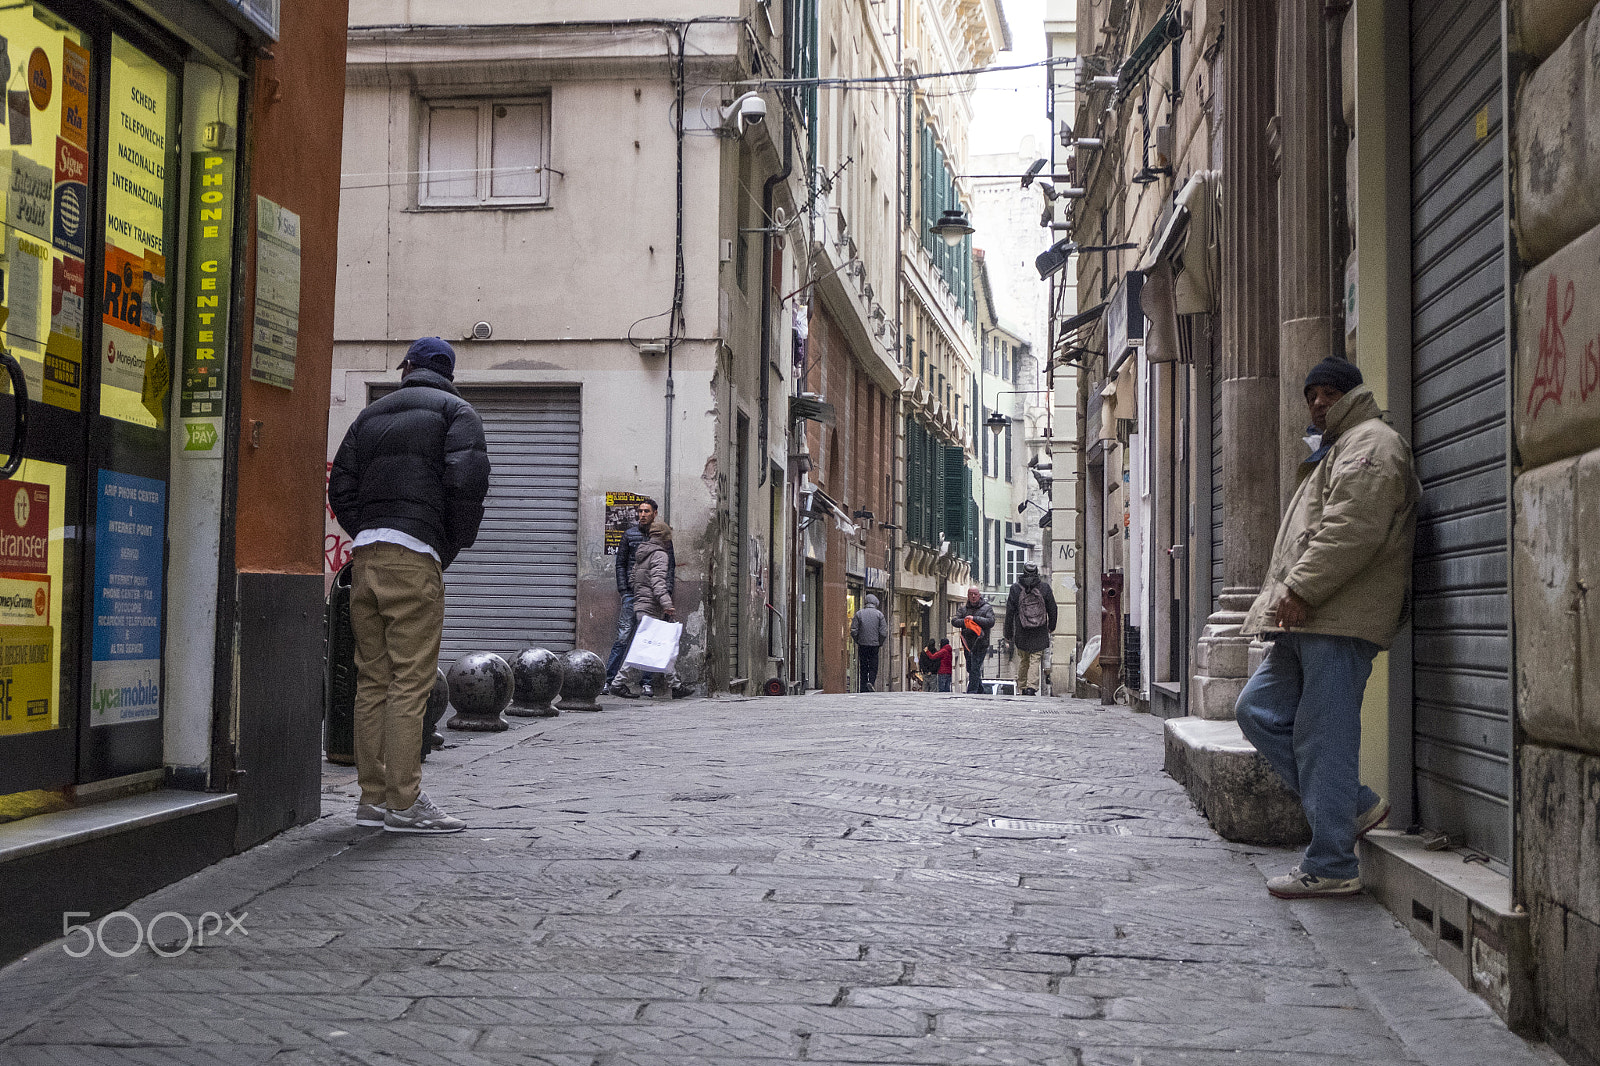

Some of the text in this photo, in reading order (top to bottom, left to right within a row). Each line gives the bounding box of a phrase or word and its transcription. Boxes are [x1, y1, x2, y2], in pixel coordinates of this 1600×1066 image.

[131, 86, 156, 114] SCHEDE
[66, 105, 82, 129] Ria
[121, 111, 164, 150] TELEFONICHE
[118, 142, 164, 180] NAZIONALI ED
[112, 171, 162, 210] INTERNAZIONA
[201, 157, 223, 238] PHONE
[19, 236, 48, 260] ORARIO
[108, 213, 162, 252] MONEY TRANSFE
[103, 262, 141, 327] Ria
[196, 261, 218, 360] CENTER
[192, 430, 215, 444] PAY
[138, 489, 159, 503] CENTER
[108, 520, 136, 534] INTERNET
[0, 529, 47, 558] transfer
[1059, 544, 1075, 560] No
[92, 679, 158, 715] Lycamobile
